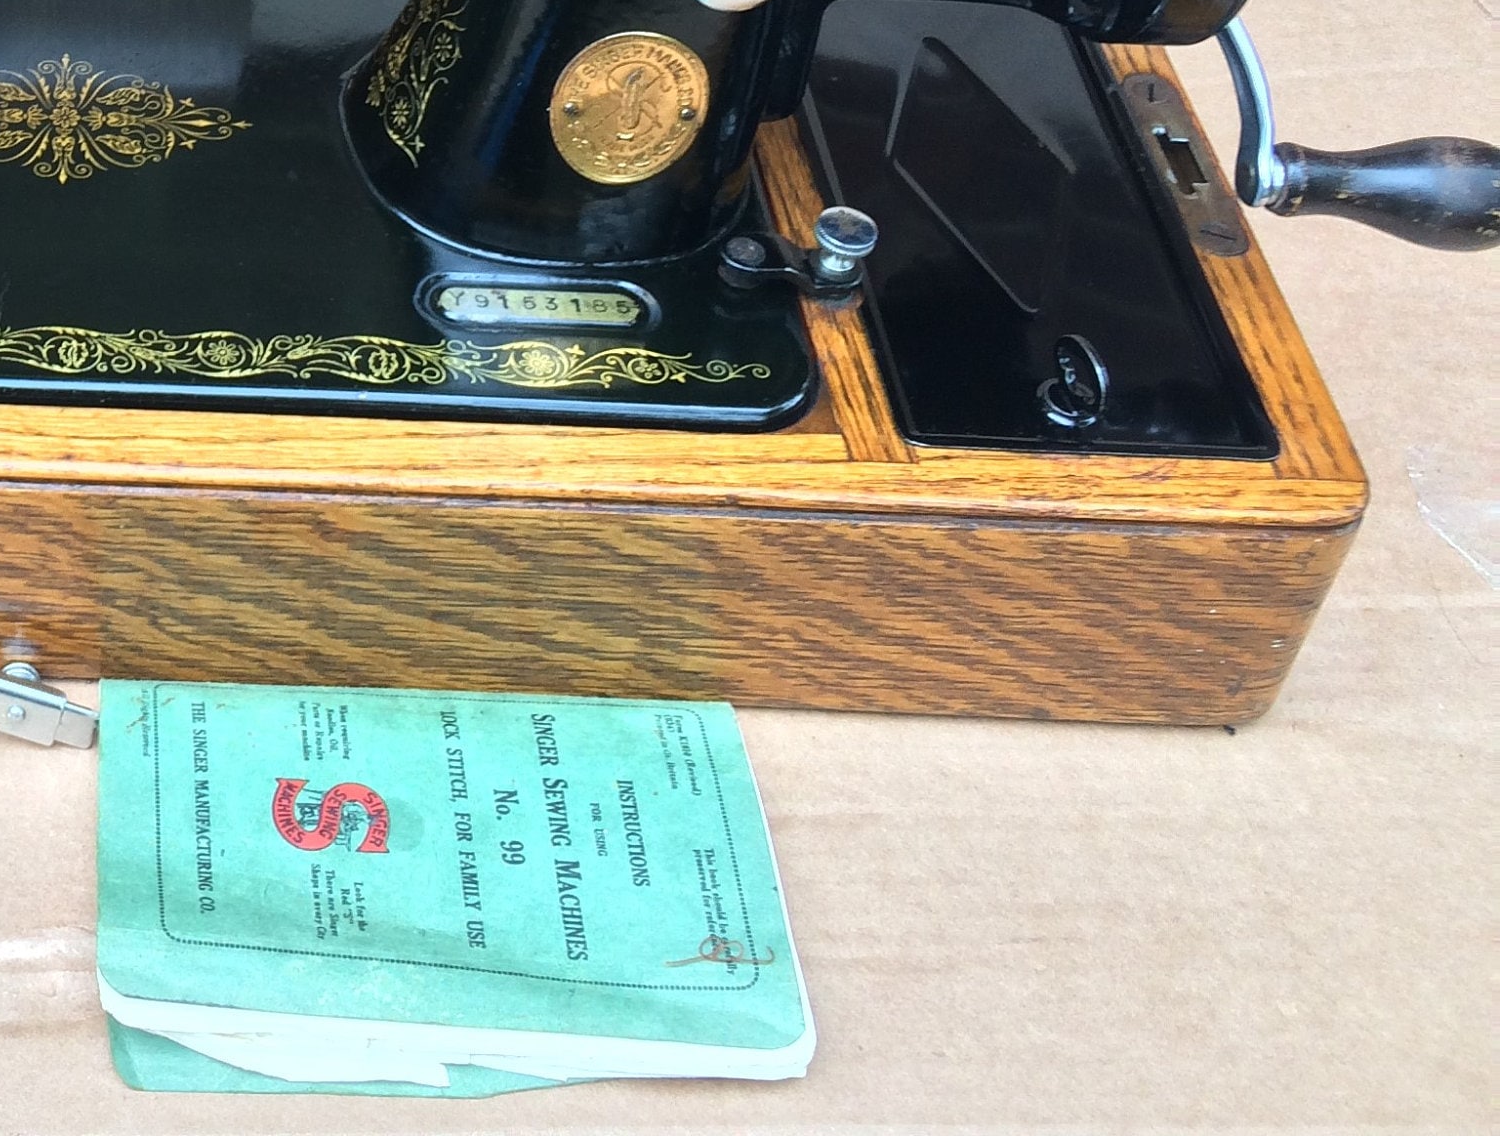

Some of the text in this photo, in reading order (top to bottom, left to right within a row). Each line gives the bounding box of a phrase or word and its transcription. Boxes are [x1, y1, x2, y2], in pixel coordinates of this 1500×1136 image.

[447, 748, 468, 803] STITCH,
[191, 702, 215, 914] THE SINGER MANUFACTURING CO.
[277, 781, 305, 843] MACHINES
[319, 789, 347, 840] SEWING
[363, 792, 387, 847] SINGER
[454, 812, 473, 842] FOR
[493, 789, 526, 865] No. 99
[590, 802, 608, 857] FOR USING
[531, 714, 588, 961] SINGER SEWING MACHINES
[616, 780, 650, 887] INSTRUCTIONS
[325, 870, 336, 894] There
[340, 888, 352, 905] Red
[459, 851, 482, 911] FAMILY
[702, 894, 712, 908] for
[709, 868, 721, 889] book
[314, 902, 323, 924] every
[327, 897, 335, 911] are
[353, 882, 368, 931] Look for the
[712, 892, 728, 920] should
[719, 923, 729, 934] be
[466, 920, 486, 949] USE
